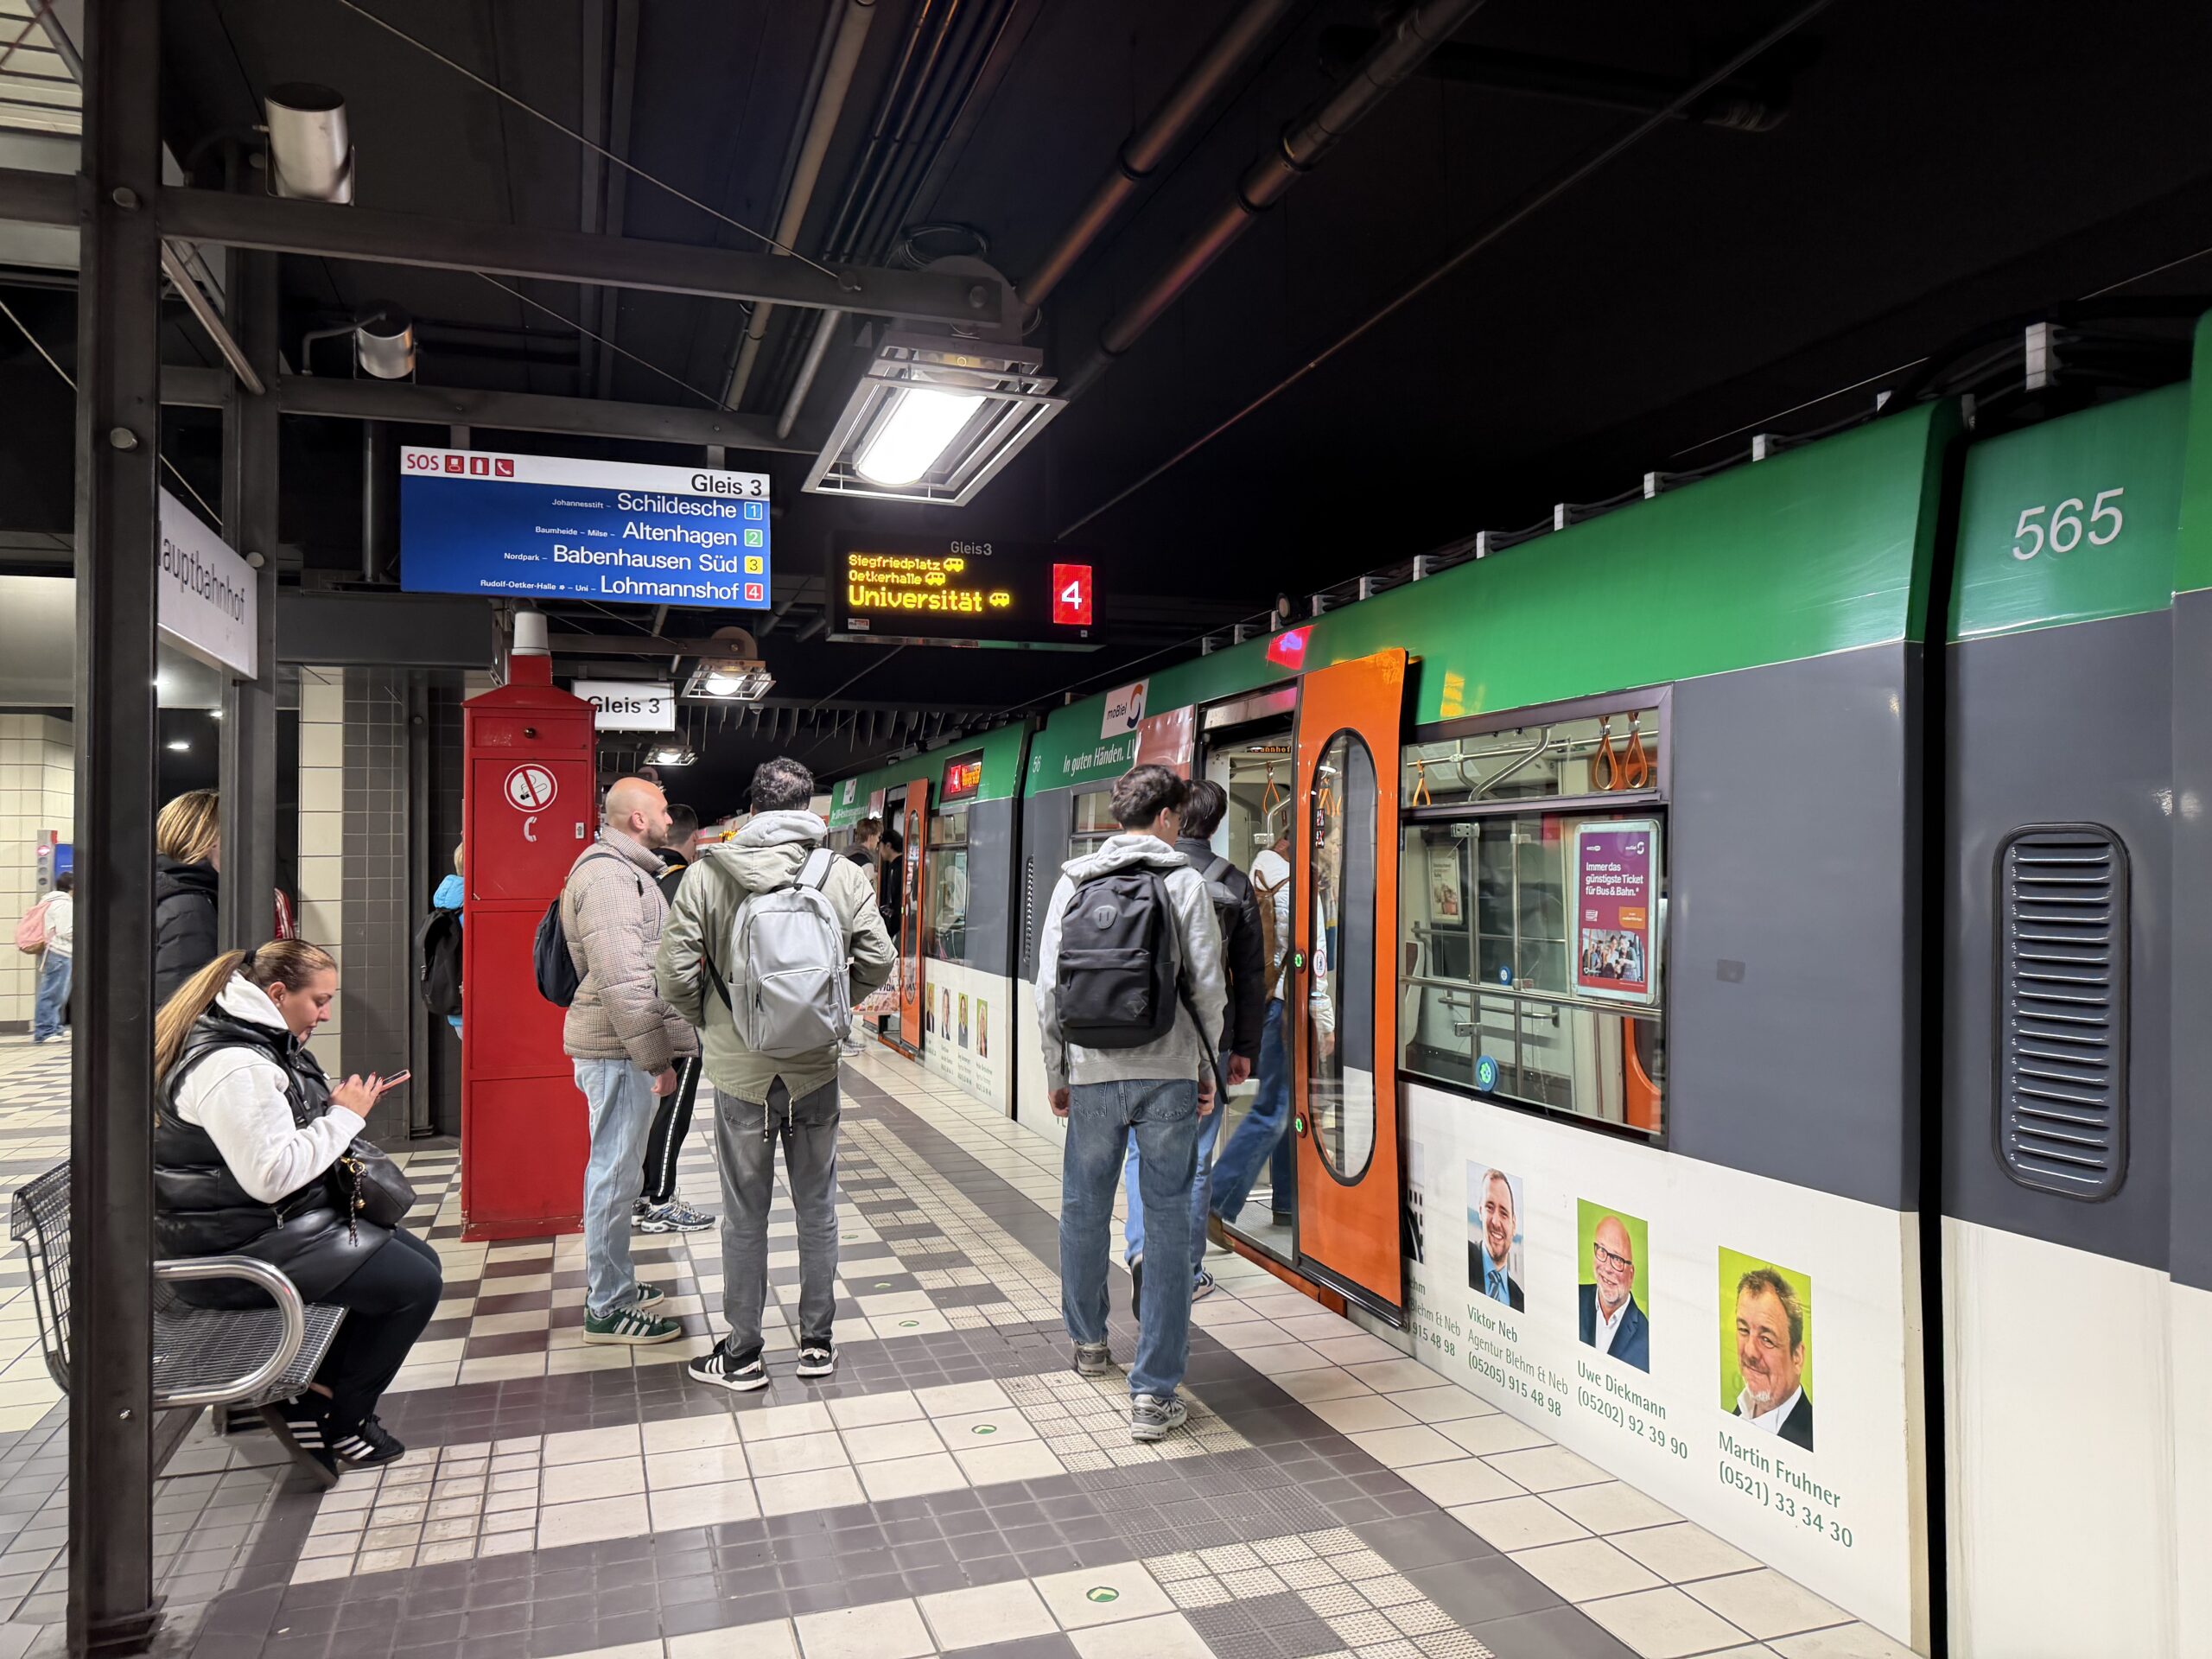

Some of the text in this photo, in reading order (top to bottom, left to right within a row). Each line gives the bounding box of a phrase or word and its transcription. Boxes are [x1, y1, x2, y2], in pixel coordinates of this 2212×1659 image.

[407, 454, 439, 471] SOS
[691, 474, 762, 496] Gleis 3
[551, 499, 604, 509] Johannesstift
[617, 493, 737, 518] Schildesche
[535, 525, 578, 536] Baumheide
[588, 529, 608, 537] Milse
[622, 521, 737, 549] Altenhagen
[2012, 487, 2124, 560] 565
[158, 520, 245, 625] auptbahnhof
[504, 552, 540, 562] Nordpark
[553, 544, 691, 570] Babenhausen
[698, 554, 738, 574] Süd
[849, 554, 941, 571] Siegfriedplatz
[480, 580, 556, 590] Rudolf-Oetker-Halle
[601, 575, 740, 601] Lohmannshof
[849, 570, 923, 585] Oetkerhalle
[849, 584, 982, 612] Universität
[1061, 580, 1083, 610] 4
[586, 696, 661, 714] Gleis 3
[1107, 702, 1128, 720] moBiel
[1063, 755, 1071, 773] In
[1071, 752, 1092, 777] guten
[1093, 743, 1124, 767] Händen.
[1586, 861, 1622, 872] Immer das
[1586, 874, 1644, 886] günstigste Ticket
[1586, 886, 1596, 895] für
[1596, 886, 1610, 896] Bus
[1610, 886, 1616, 896] &
[1435, 1312, 1443, 1328] &
[1444, 1315, 1460, 1337] Neb
[1467, 1303, 1517, 1343] Viktor Neb
[1413, 1321, 1428, 1341] 915
[1430, 1332, 1441, 1349] 48
[1444, 1339, 1455, 1357] 98
[1468, 1328, 1568, 1395] Agentur Blehm & Neb
[1468, 1351, 1561, 1417] (05205) 915 48 98
[1578, 1359, 1666, 1421] Uwe Diekmann
[1578, 1386, 1688, 1459] (05202) 92 39 90
[1719, 1431, 1841, 1509] Martin Fruhner
[1719, 1460, 1853, 1548] (0521) 33 34 30
